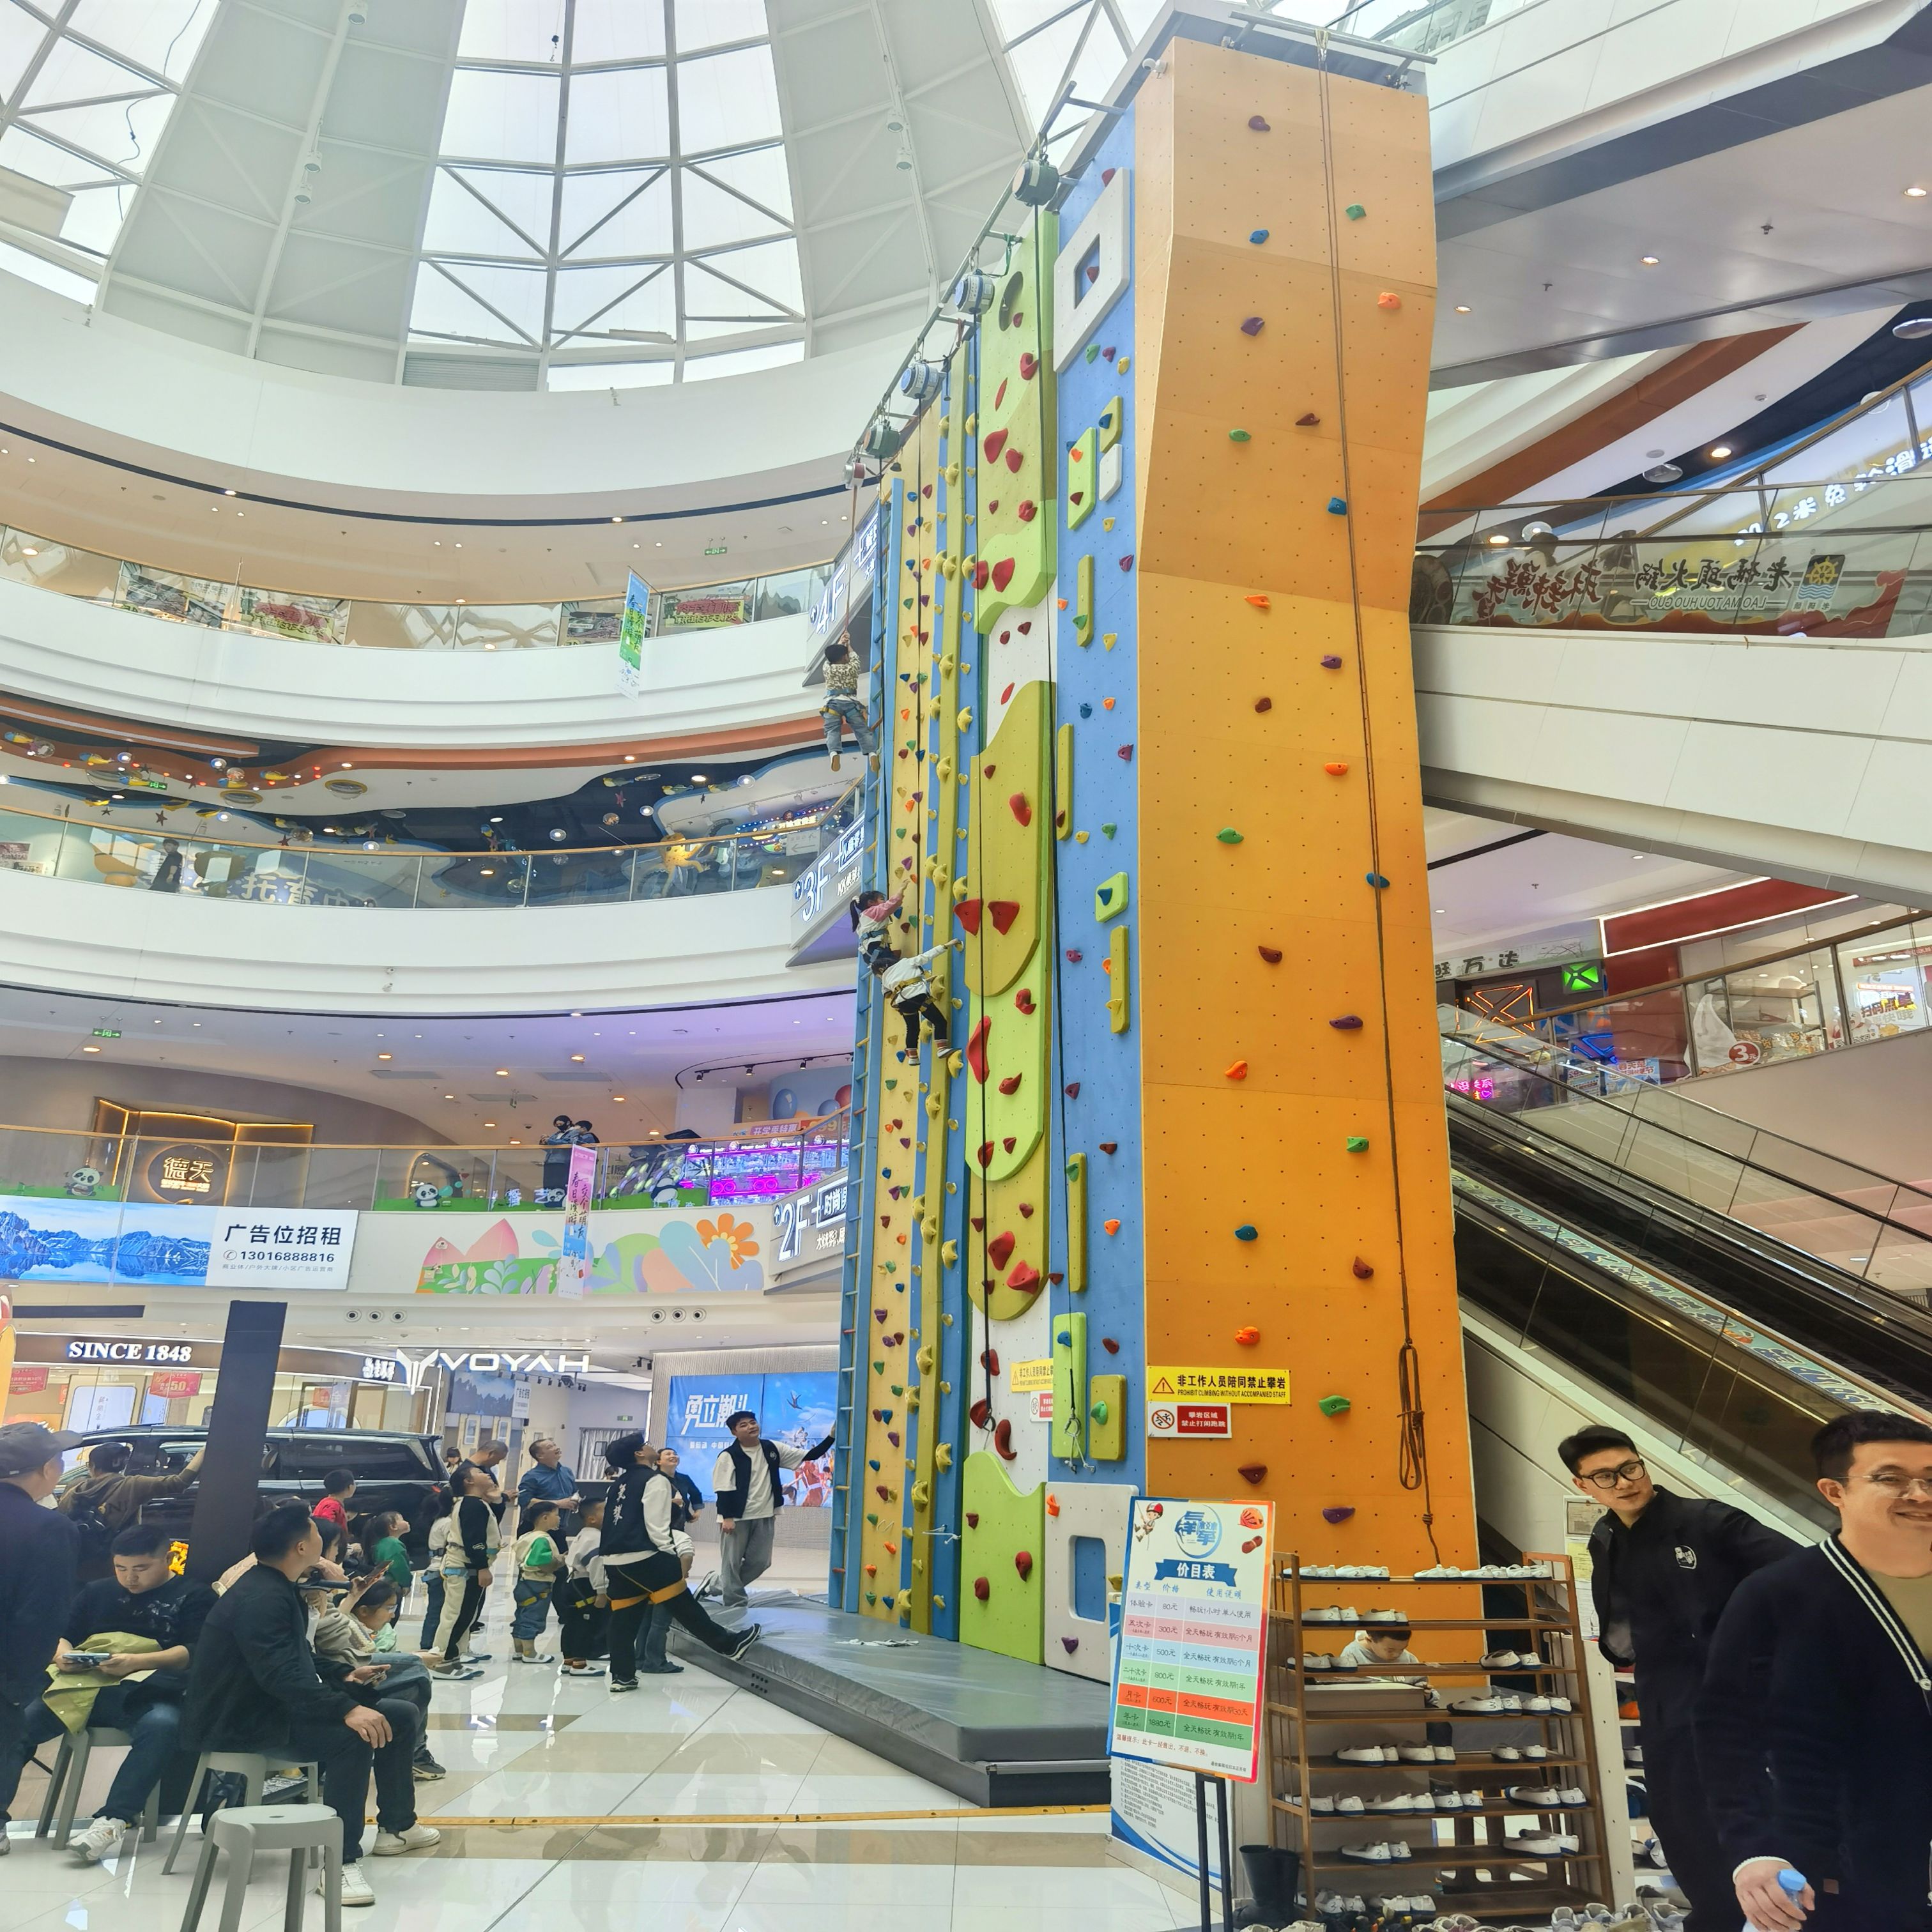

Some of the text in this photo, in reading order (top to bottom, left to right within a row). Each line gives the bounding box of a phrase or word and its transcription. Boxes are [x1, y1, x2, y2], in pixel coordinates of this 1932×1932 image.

[815, 563, 848, 634] 4F
[802, 852, 832, 922] 3F
[224, 1223, 342, 1245] 广告位招租
[778, 1193, 813, 1262] 2F
[240, 1250, 335, 1262] 13016888816
[68, 1341, 193, 1362] SINCE 1848
[439, 1352, 590, 1373] VOYAH
[1177, 1374, 1286, 1390] 非工作人员陪同禁止攀岩
[1181, 1420, 1226, 1428] 禁止打闹跑跳
[1176, 1561, 1216, 1579] 价目表
[1162, 1583, 1180, 1593] 价格
[1206, 1588, 1242, 1600] 使用说明
[1130, 1599, 1153, 1608] 体验卡
[1222, 1608, 1252, 1619] 单人使用
[1128, 1620, 1151, 1629] 五次卡
[1158, 1625, 1178, 1634] 300元
[1185, 1627, 1213, 1638] 全天畅玩
[1126, 1643, 1149, 1652] 十次卡
[1156, 1648, 1176, 1657] 500元
[1183, 1652, 1211, 1662] 全天畅玩
[1154, 1671, 1174, 1680] 800元
[1185, 1675, 1214, 1686] 全天畅玩
[1126, 1690, 1142, 1699] 月卡
[1183, 1699, 1211, 1710] 全天畅玩
[1123, 1712, 1140, 1721] 年卡
[1183, 1724, 1212, 1736] 全天畅玩
